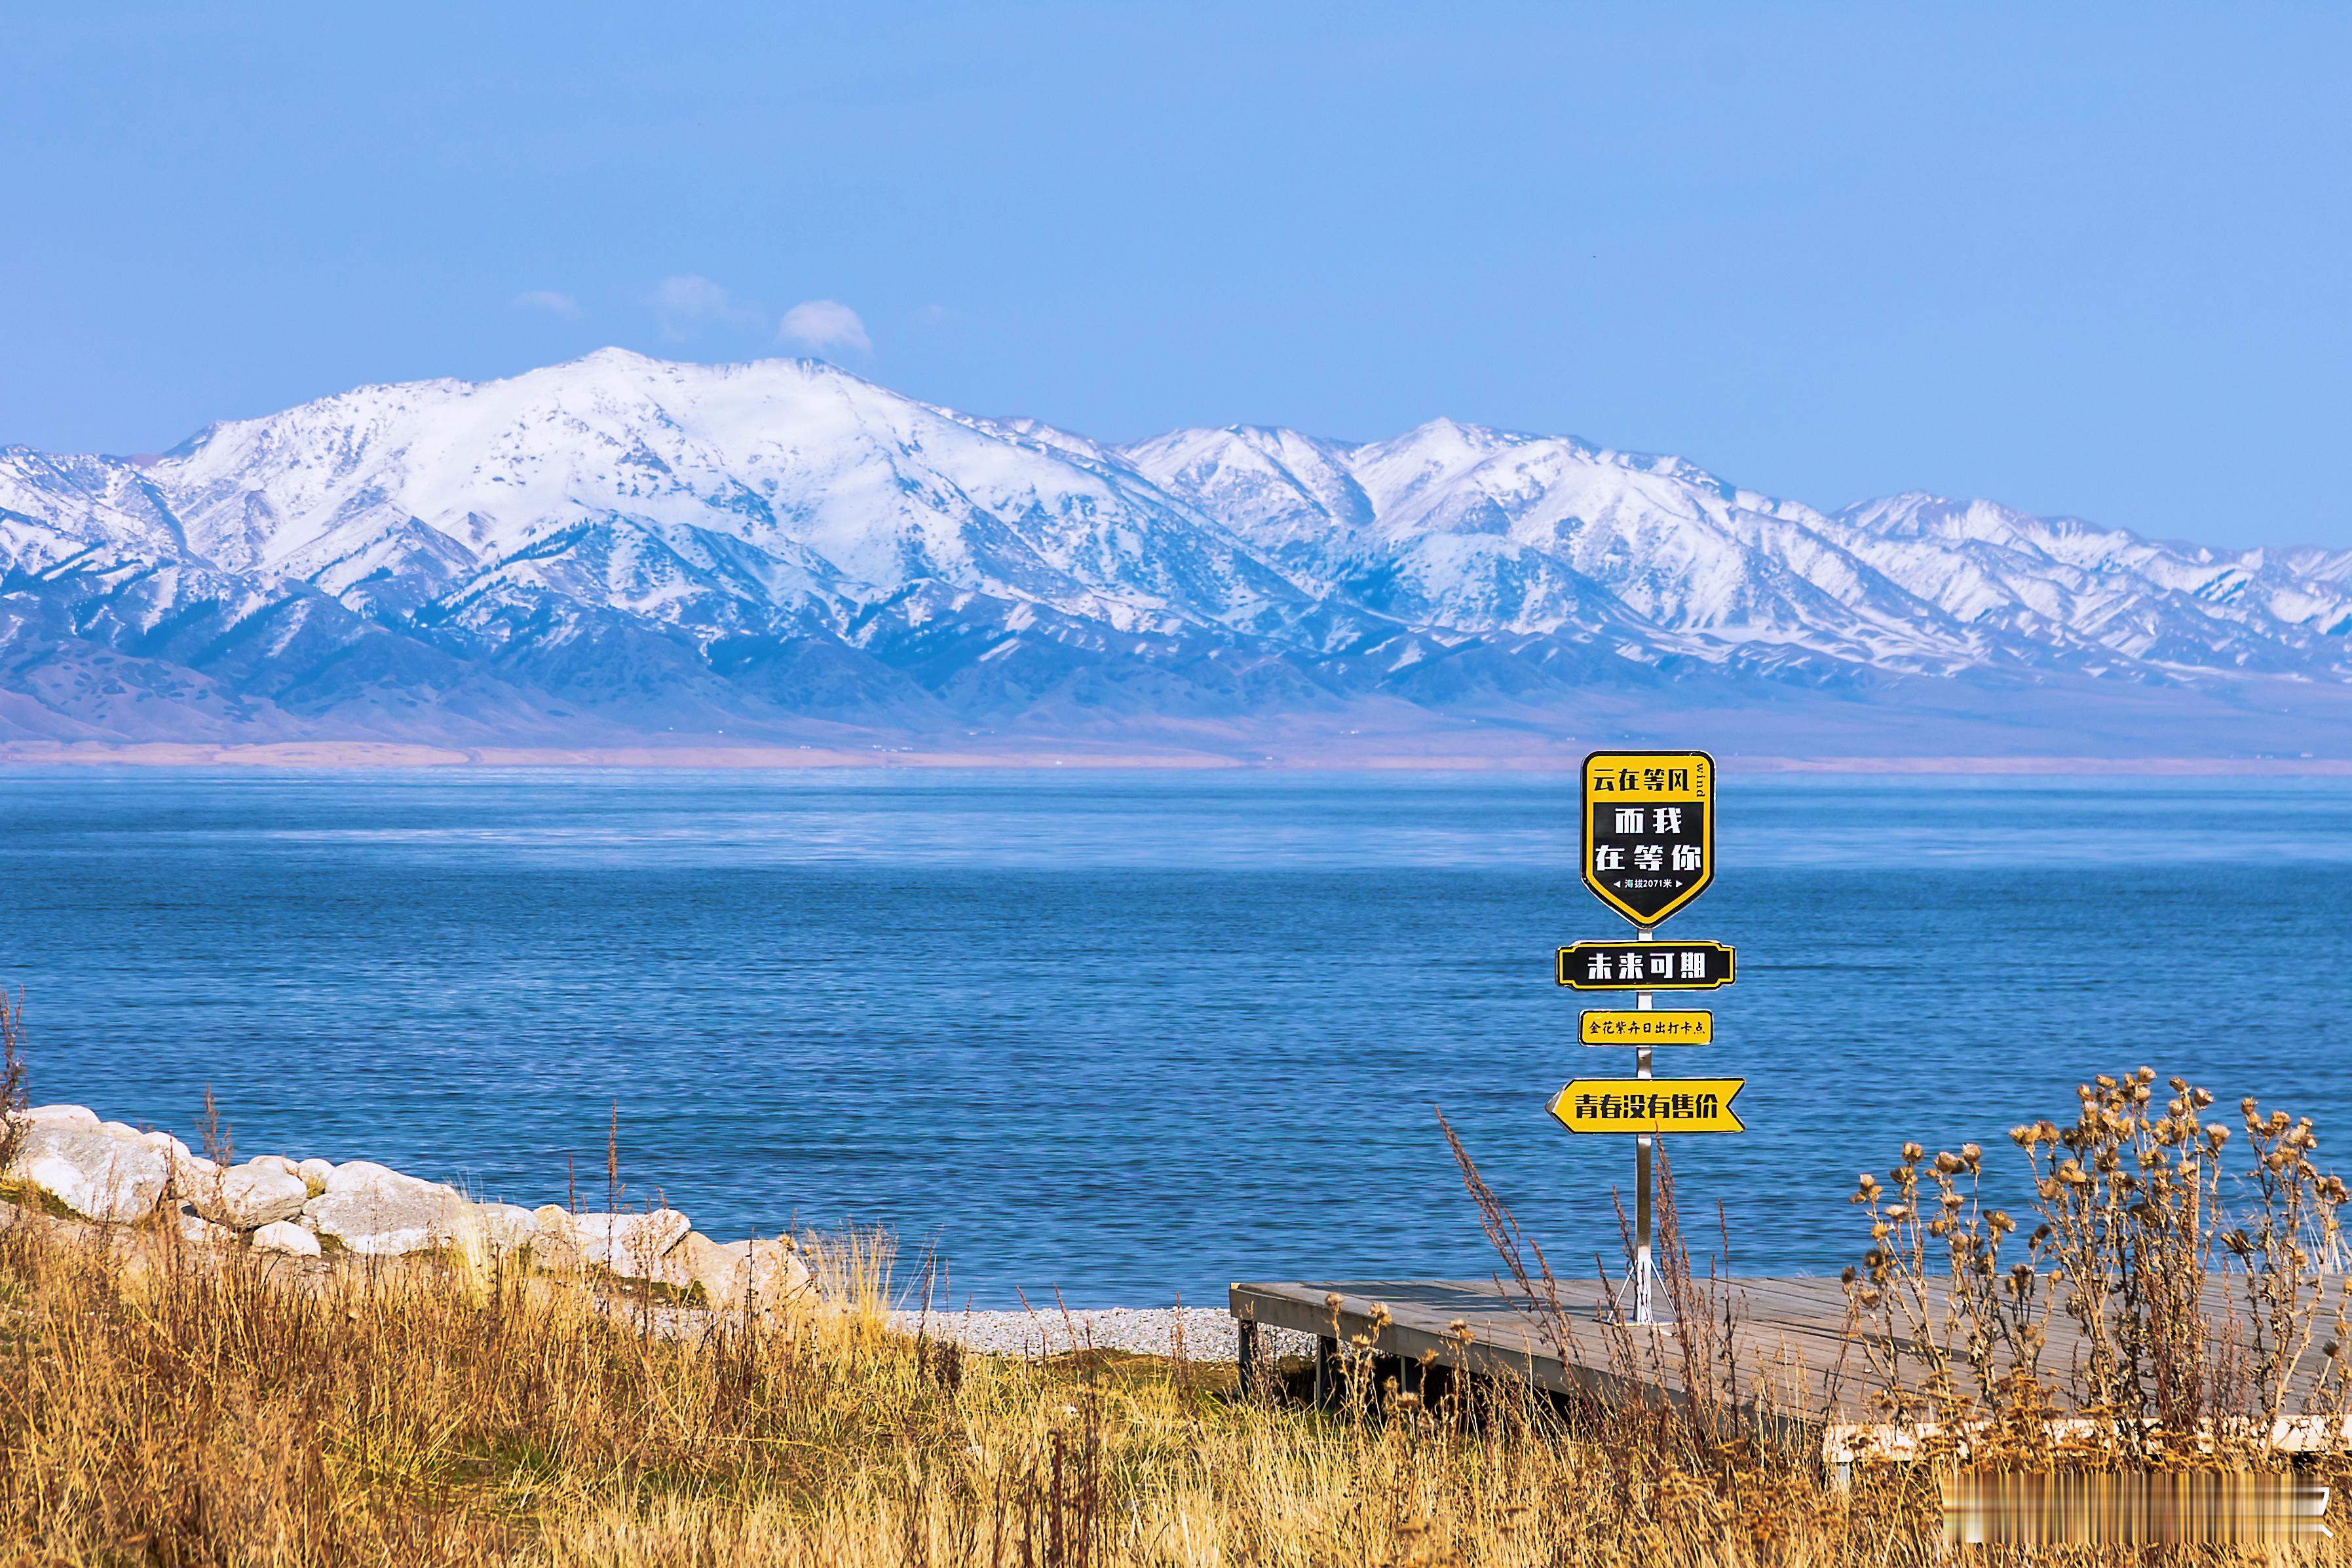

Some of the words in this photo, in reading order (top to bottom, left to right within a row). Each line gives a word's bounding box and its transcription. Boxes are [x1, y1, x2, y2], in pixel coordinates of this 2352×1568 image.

[1593, 768, 1690, 791] 云在等风
[1696, 763, 1705, 797] wind
[1625, 879, 1673, 888] 海拔2071米
[1587, 952, 1705, 979] 未来可期
[1589, 1021, 1705, 1035] 金花紫卉日出打卡点
[1575, 1094, 1718, 1119] 青春没有售价
